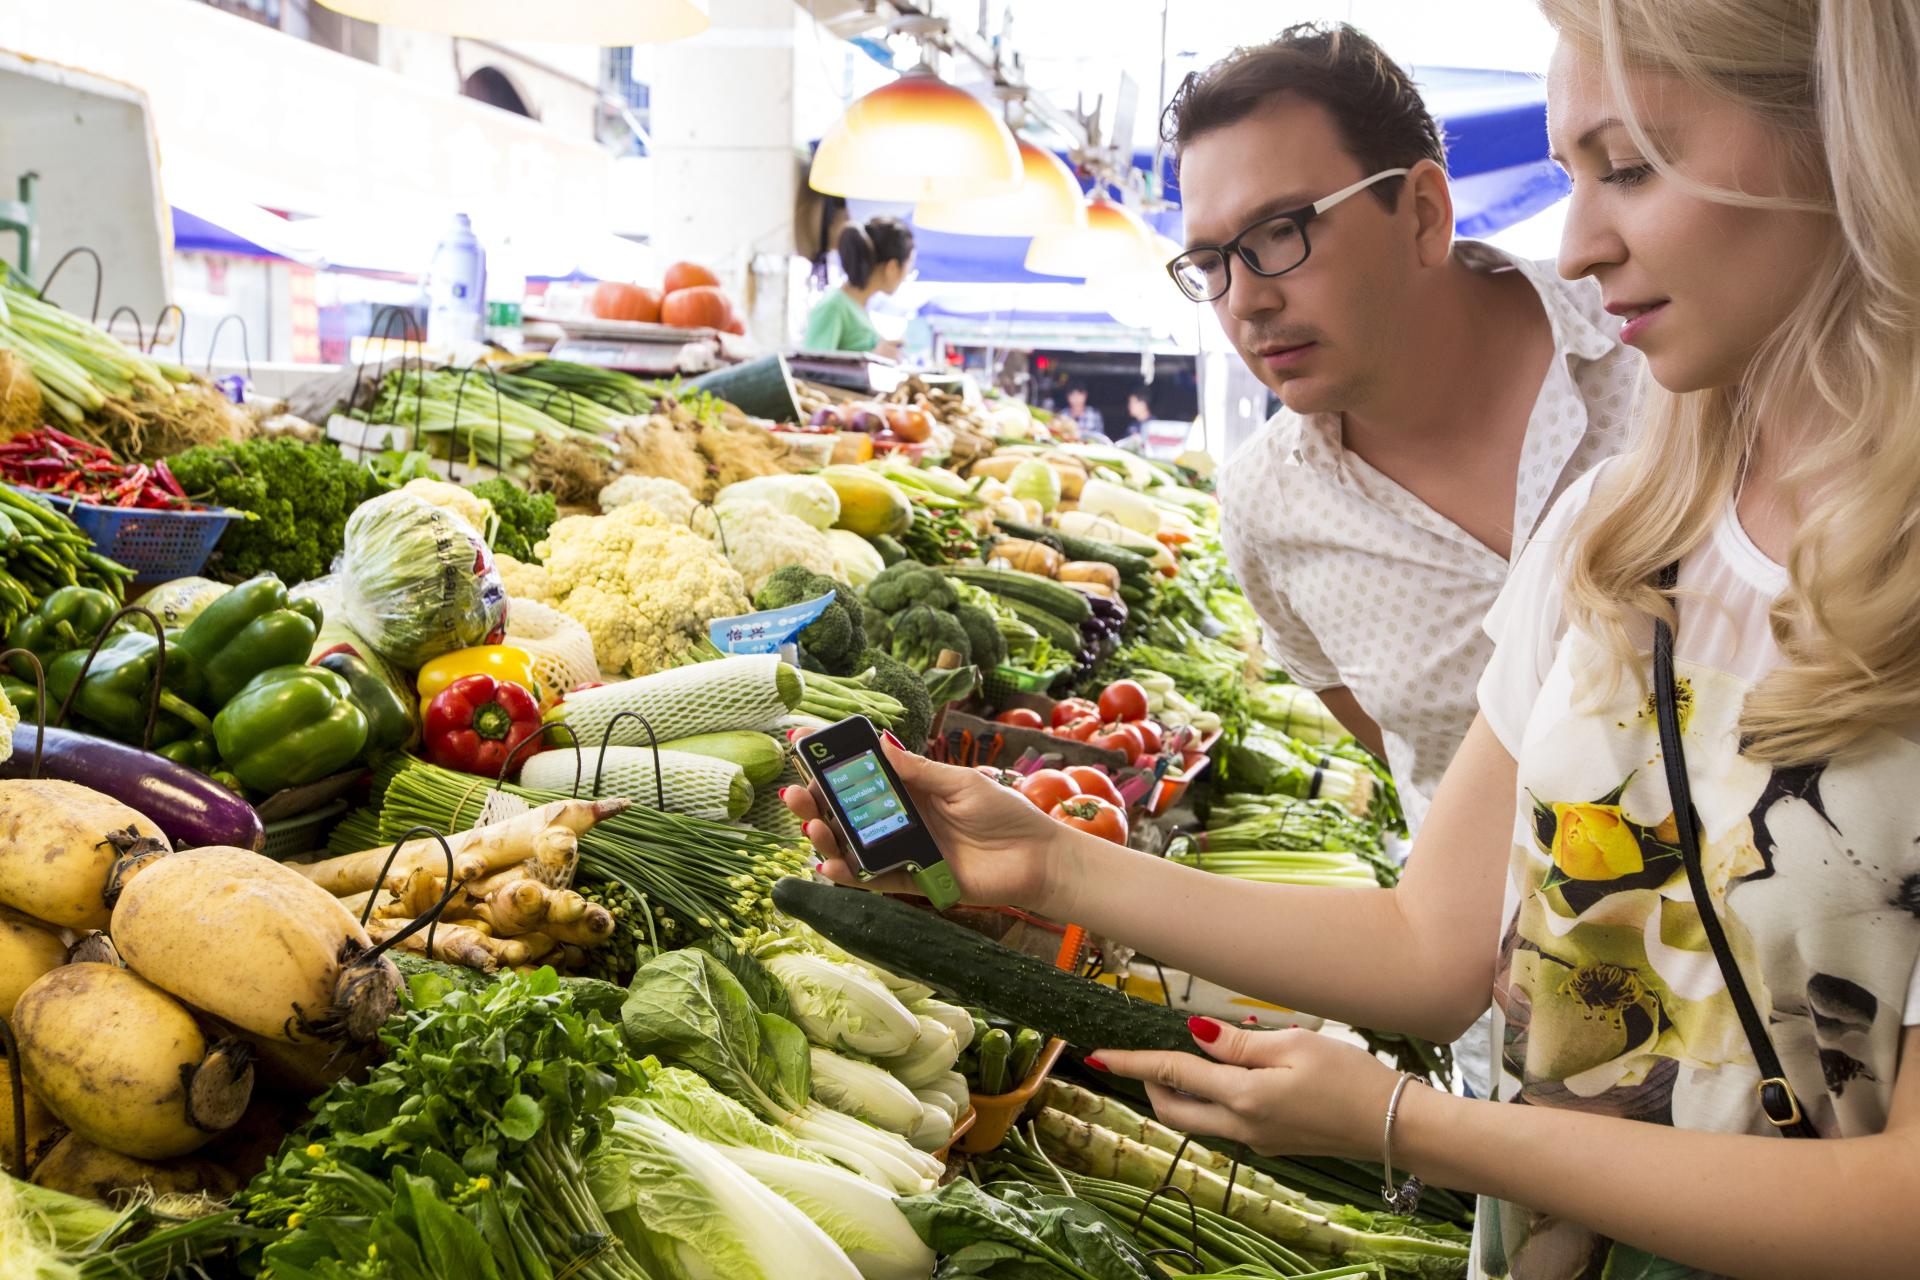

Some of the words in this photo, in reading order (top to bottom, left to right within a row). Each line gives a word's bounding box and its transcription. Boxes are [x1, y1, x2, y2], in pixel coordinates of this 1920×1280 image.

[808, 742, 828, 758] G
[832, 774, 849, 785] Fruit
[843, 786, 877, 804] Vegetables
[853, 812, 869, 824] Meat
[862, 824, 888, 840] Settings
